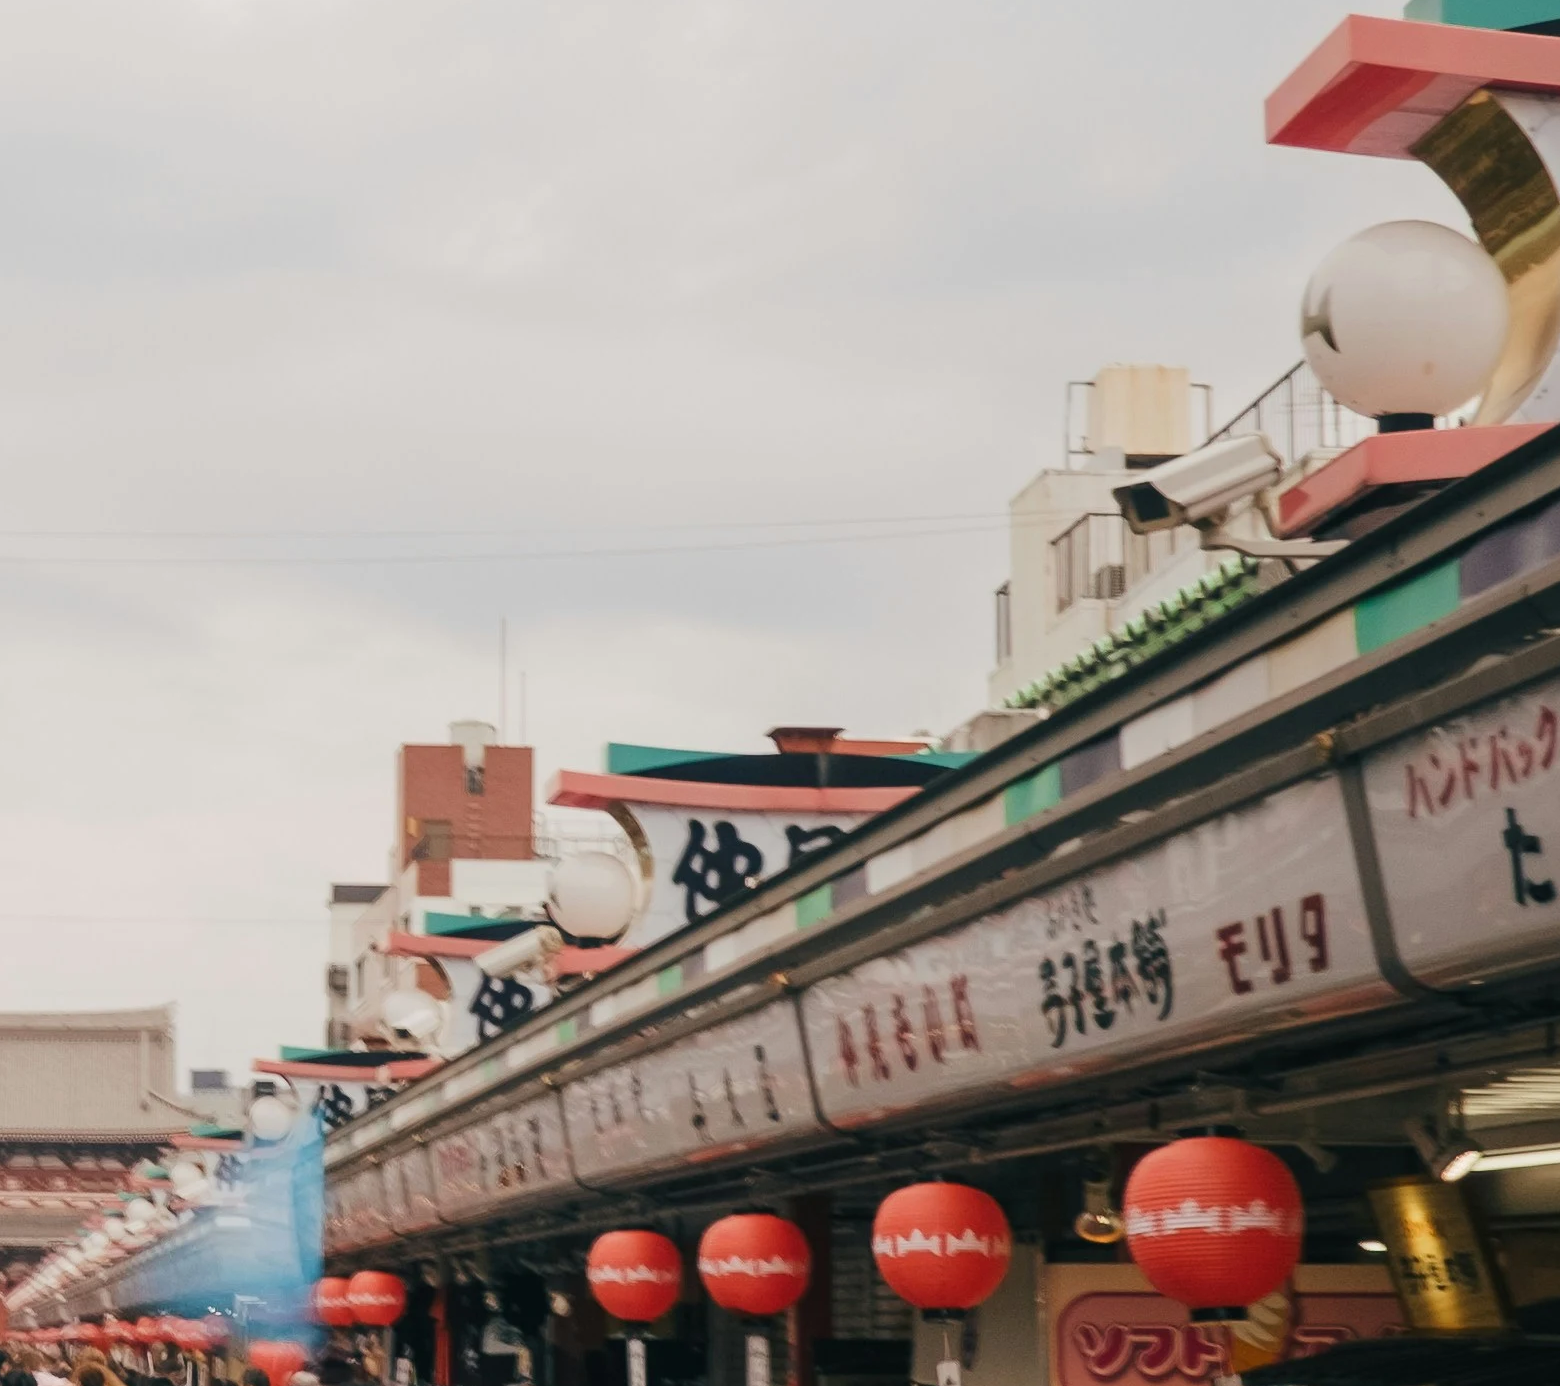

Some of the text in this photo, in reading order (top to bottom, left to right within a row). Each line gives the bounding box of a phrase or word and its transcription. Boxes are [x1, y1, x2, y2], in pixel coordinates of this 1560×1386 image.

[1215, 892, 1330, 995] モリタ
[1071, 1323, 1224, 1380] ソフト
